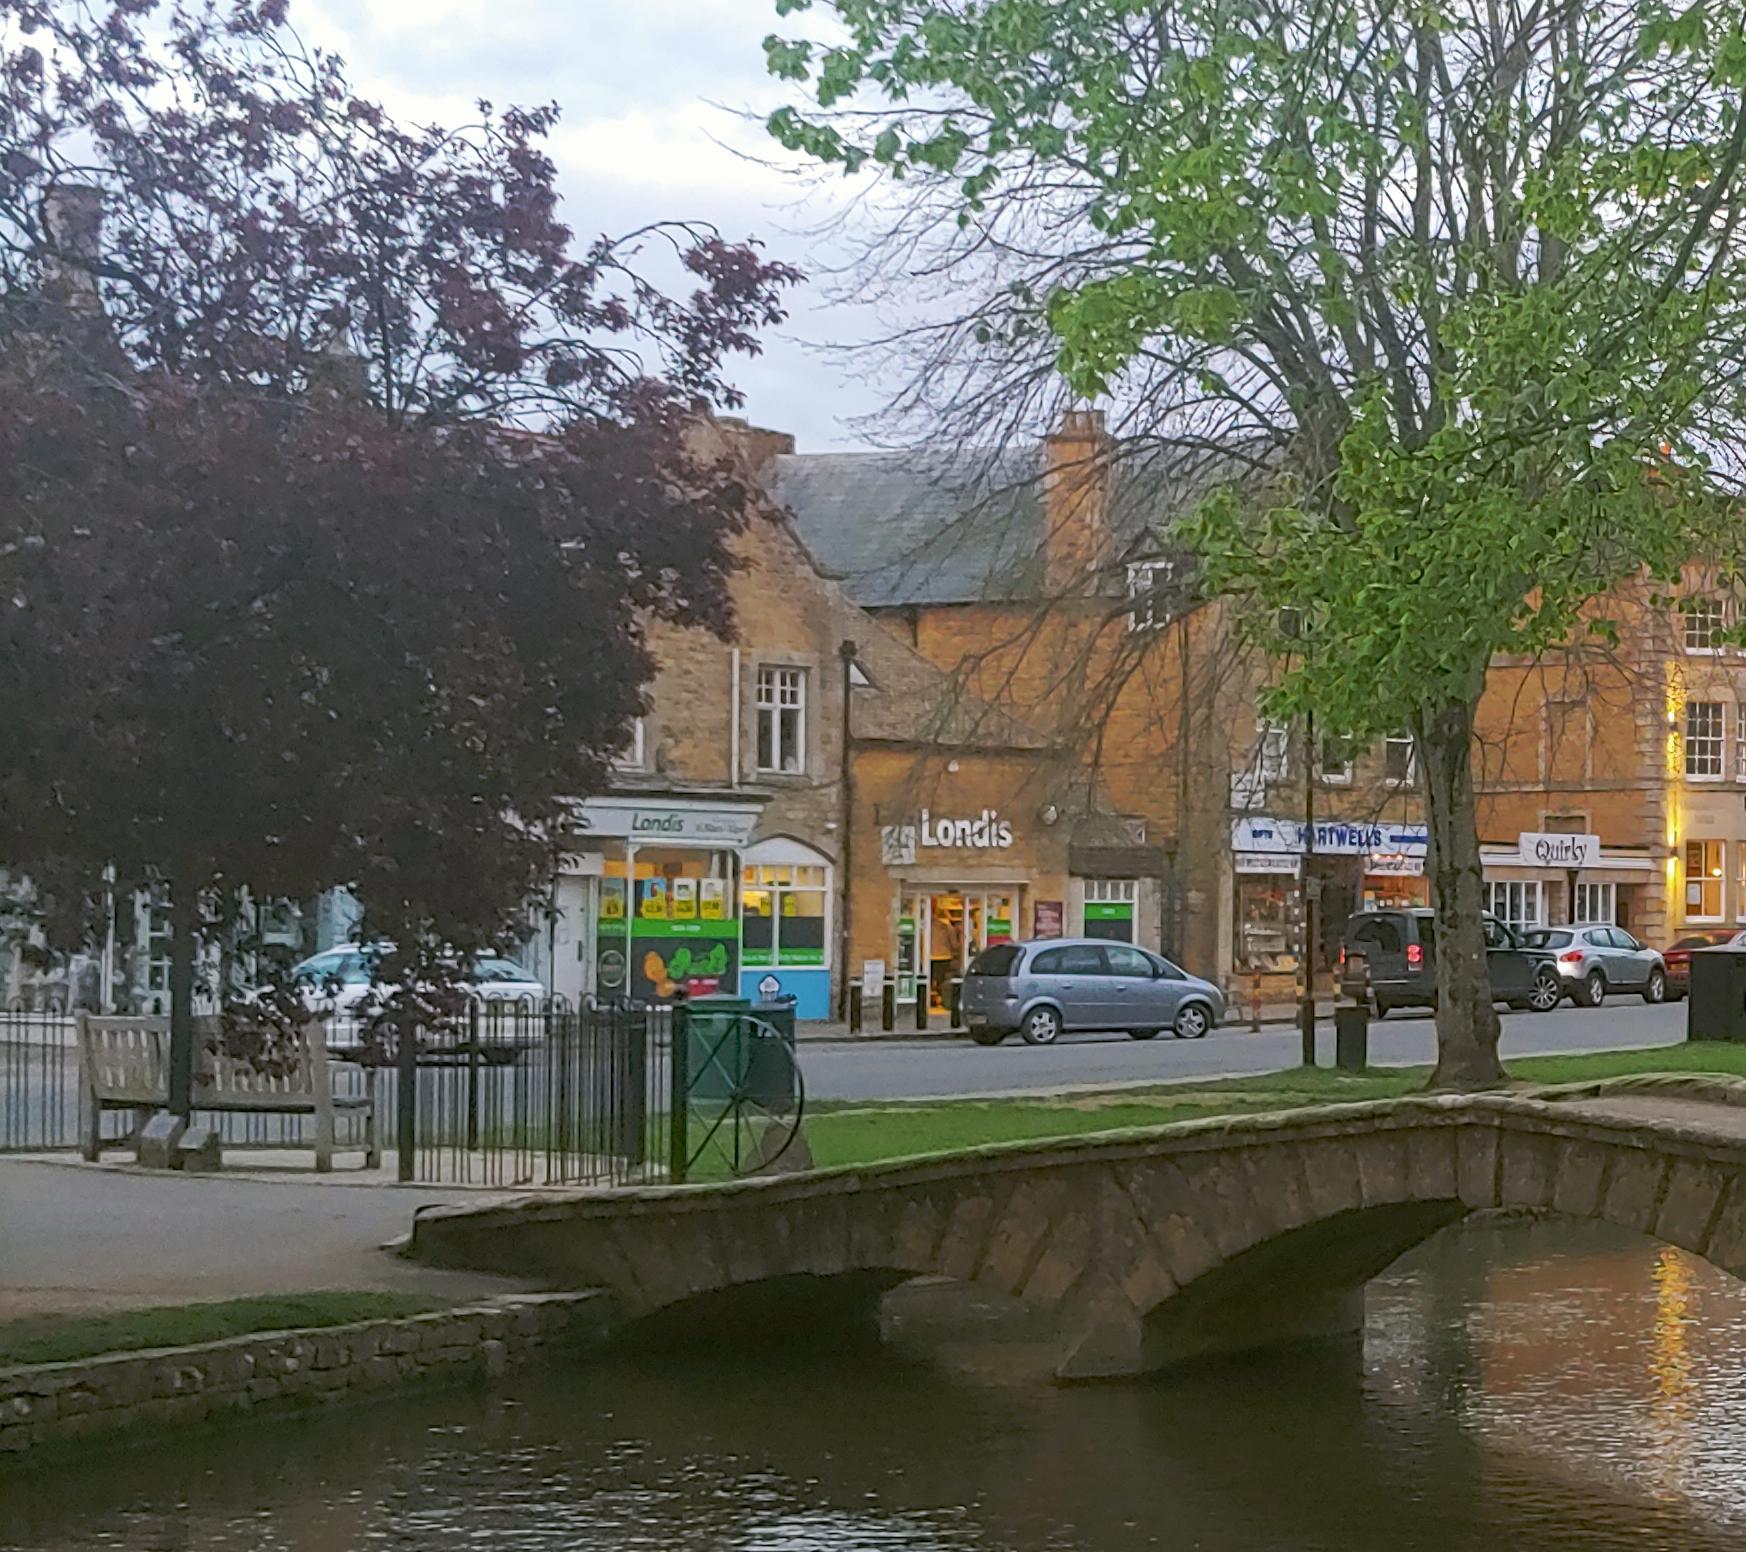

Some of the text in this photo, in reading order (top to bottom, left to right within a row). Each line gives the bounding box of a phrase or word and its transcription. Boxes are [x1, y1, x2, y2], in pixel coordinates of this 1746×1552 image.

[631, 812, 684, 832] Londis
[921, 808, 1013, 847] Londis
[1536, 836, 1587, 865] Quirky
